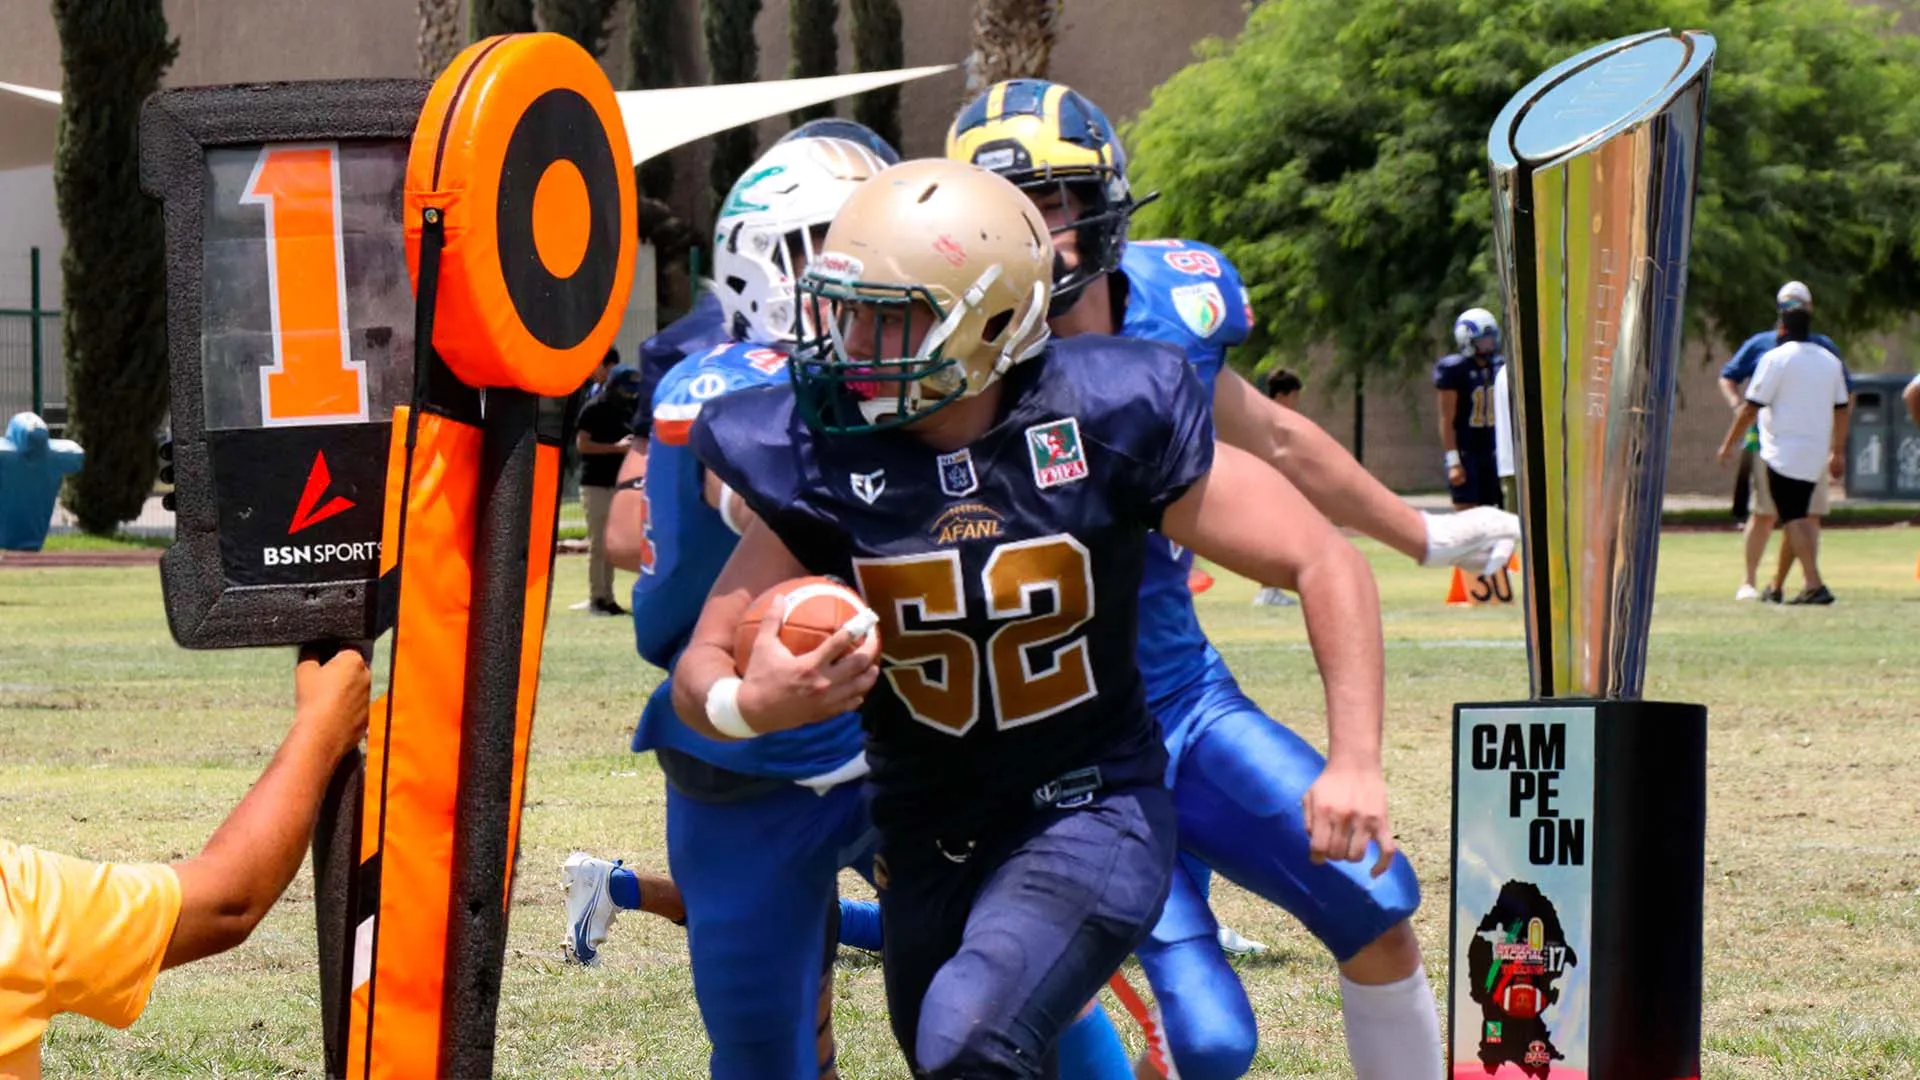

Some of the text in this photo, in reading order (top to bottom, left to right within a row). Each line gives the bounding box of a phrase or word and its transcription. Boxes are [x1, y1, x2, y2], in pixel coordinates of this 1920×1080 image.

[239, 142, 370, 427] 1
[263, 545, 312, 566] BSN
[1470, 565, 1513, 603] 30
[851, 532, 1098, 738] 52
[1472, 723, 1566, 770] CAM
[1509, 771, 1560, 818] PE
[1529, 819, 1585, 867] ON
[1548, 946, 1566, 972] 17
